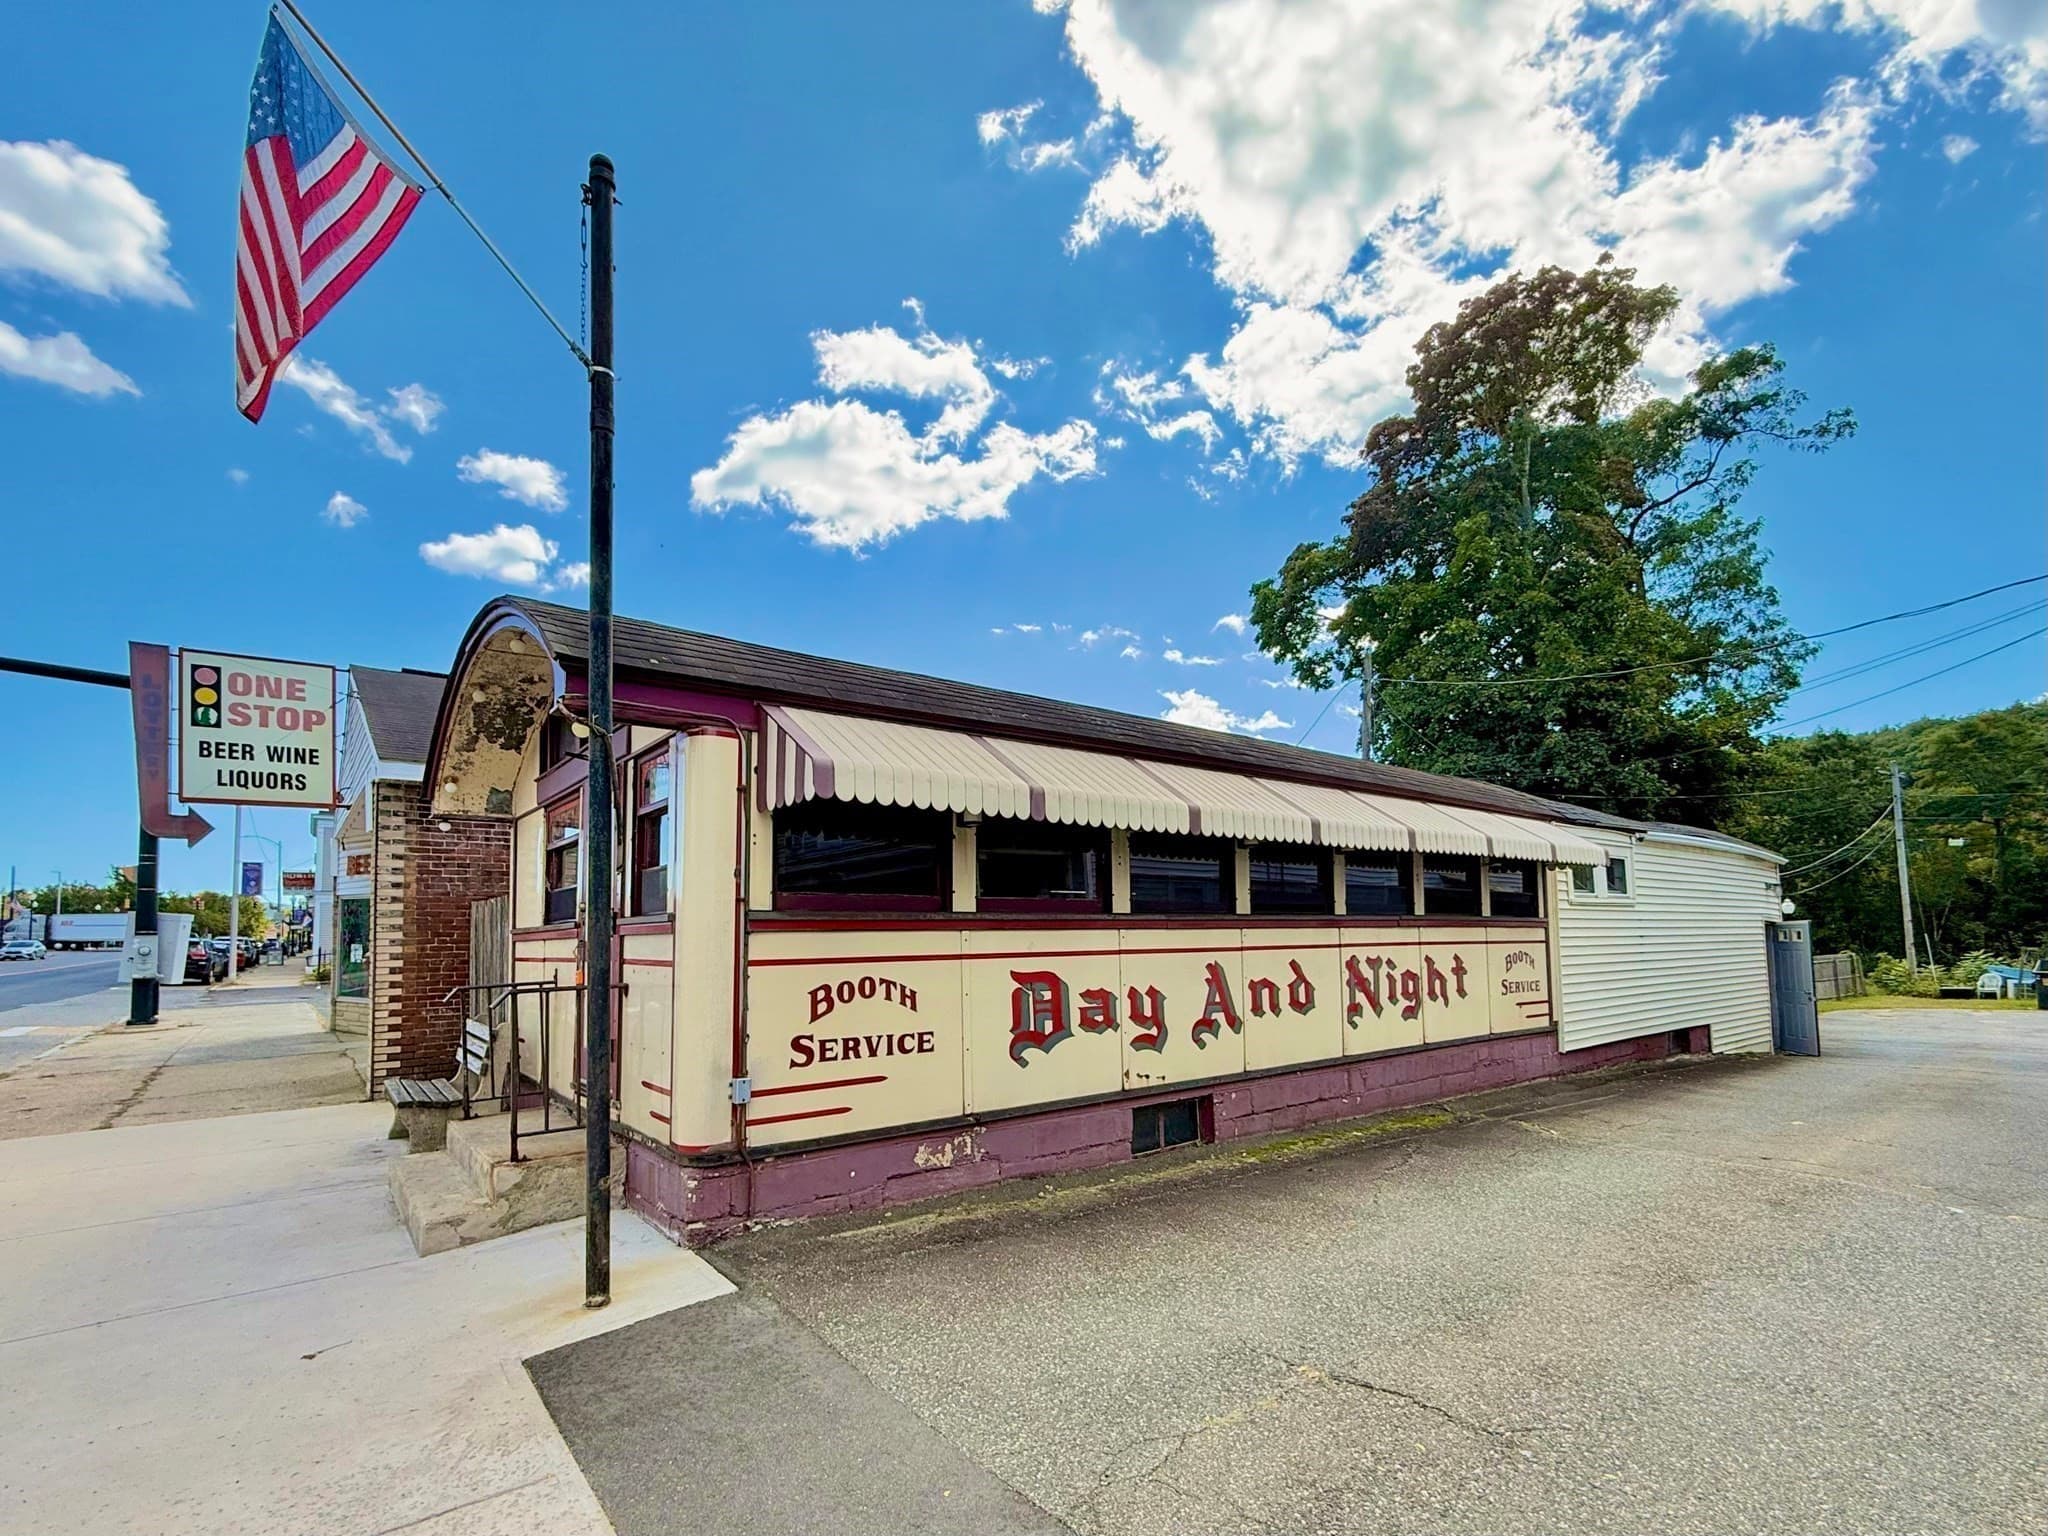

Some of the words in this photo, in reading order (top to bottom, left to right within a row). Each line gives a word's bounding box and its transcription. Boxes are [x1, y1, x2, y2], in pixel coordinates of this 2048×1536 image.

[227, 672, 306, 702] ONE
[142, 673, 162, 780] LOTTRY
[227, 702, 326, 732] STOP
[199, 740, 254, 761] BEER
[266, 745, 320, 765] WINE
[217, 769, 307, 791] LIQUORS
[1505, 950, 1535, 974] BOOTH
[807, 976, 918, 1024] BOOTH
[1501, 979, 1541, 996] SERVICE
[1009, 969, 1169, 1069] Day
[1191, 959, 1316, 1050] And
[1345, 953, 1468, 1030] Night
[789, 1031, 935, 1070] SERVICE
